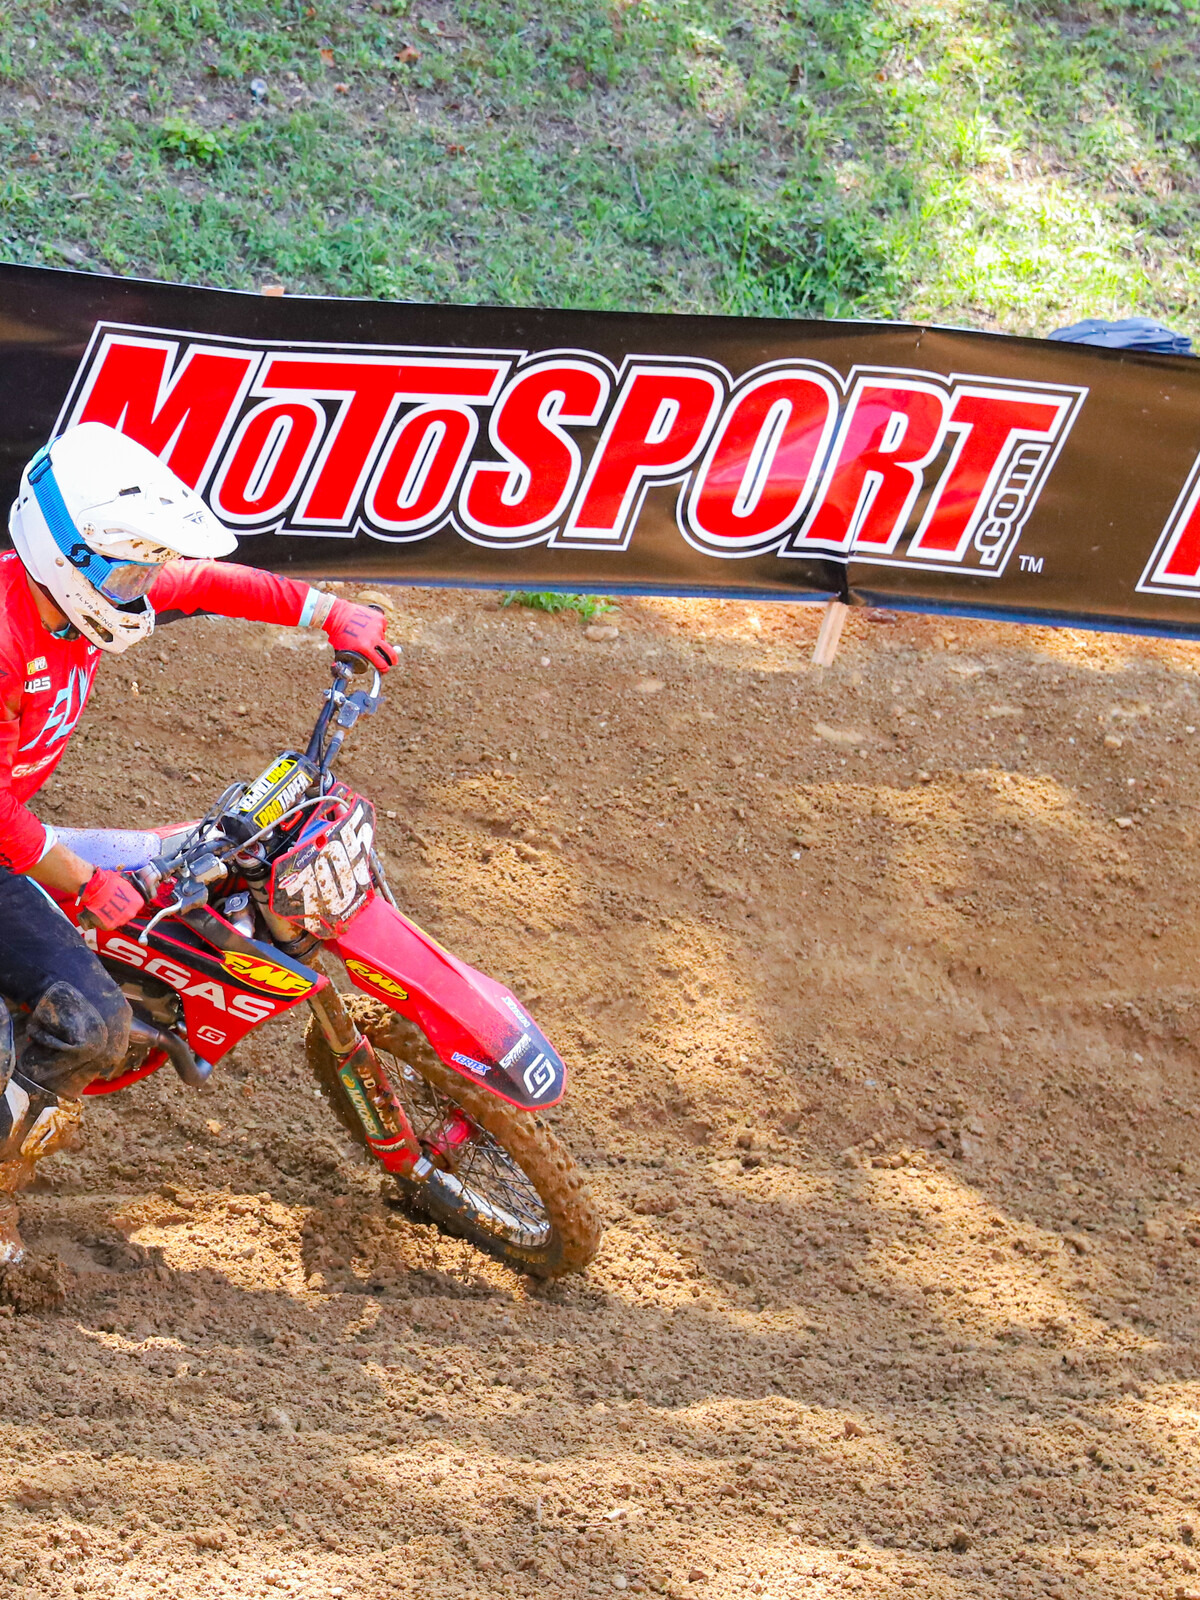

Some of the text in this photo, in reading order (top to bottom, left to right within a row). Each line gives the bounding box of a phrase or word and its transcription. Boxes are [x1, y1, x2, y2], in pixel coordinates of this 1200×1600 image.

[285, 803, 373, 932] 705
[99, 886, 131, 921] FLY
[224, 951, 314, 991] FMF
[346, 959, 409, 1000] FMF
[451, 1052, 491, 1074] VERTEX
[348, 1088, 379, 1136] MOTOREX
